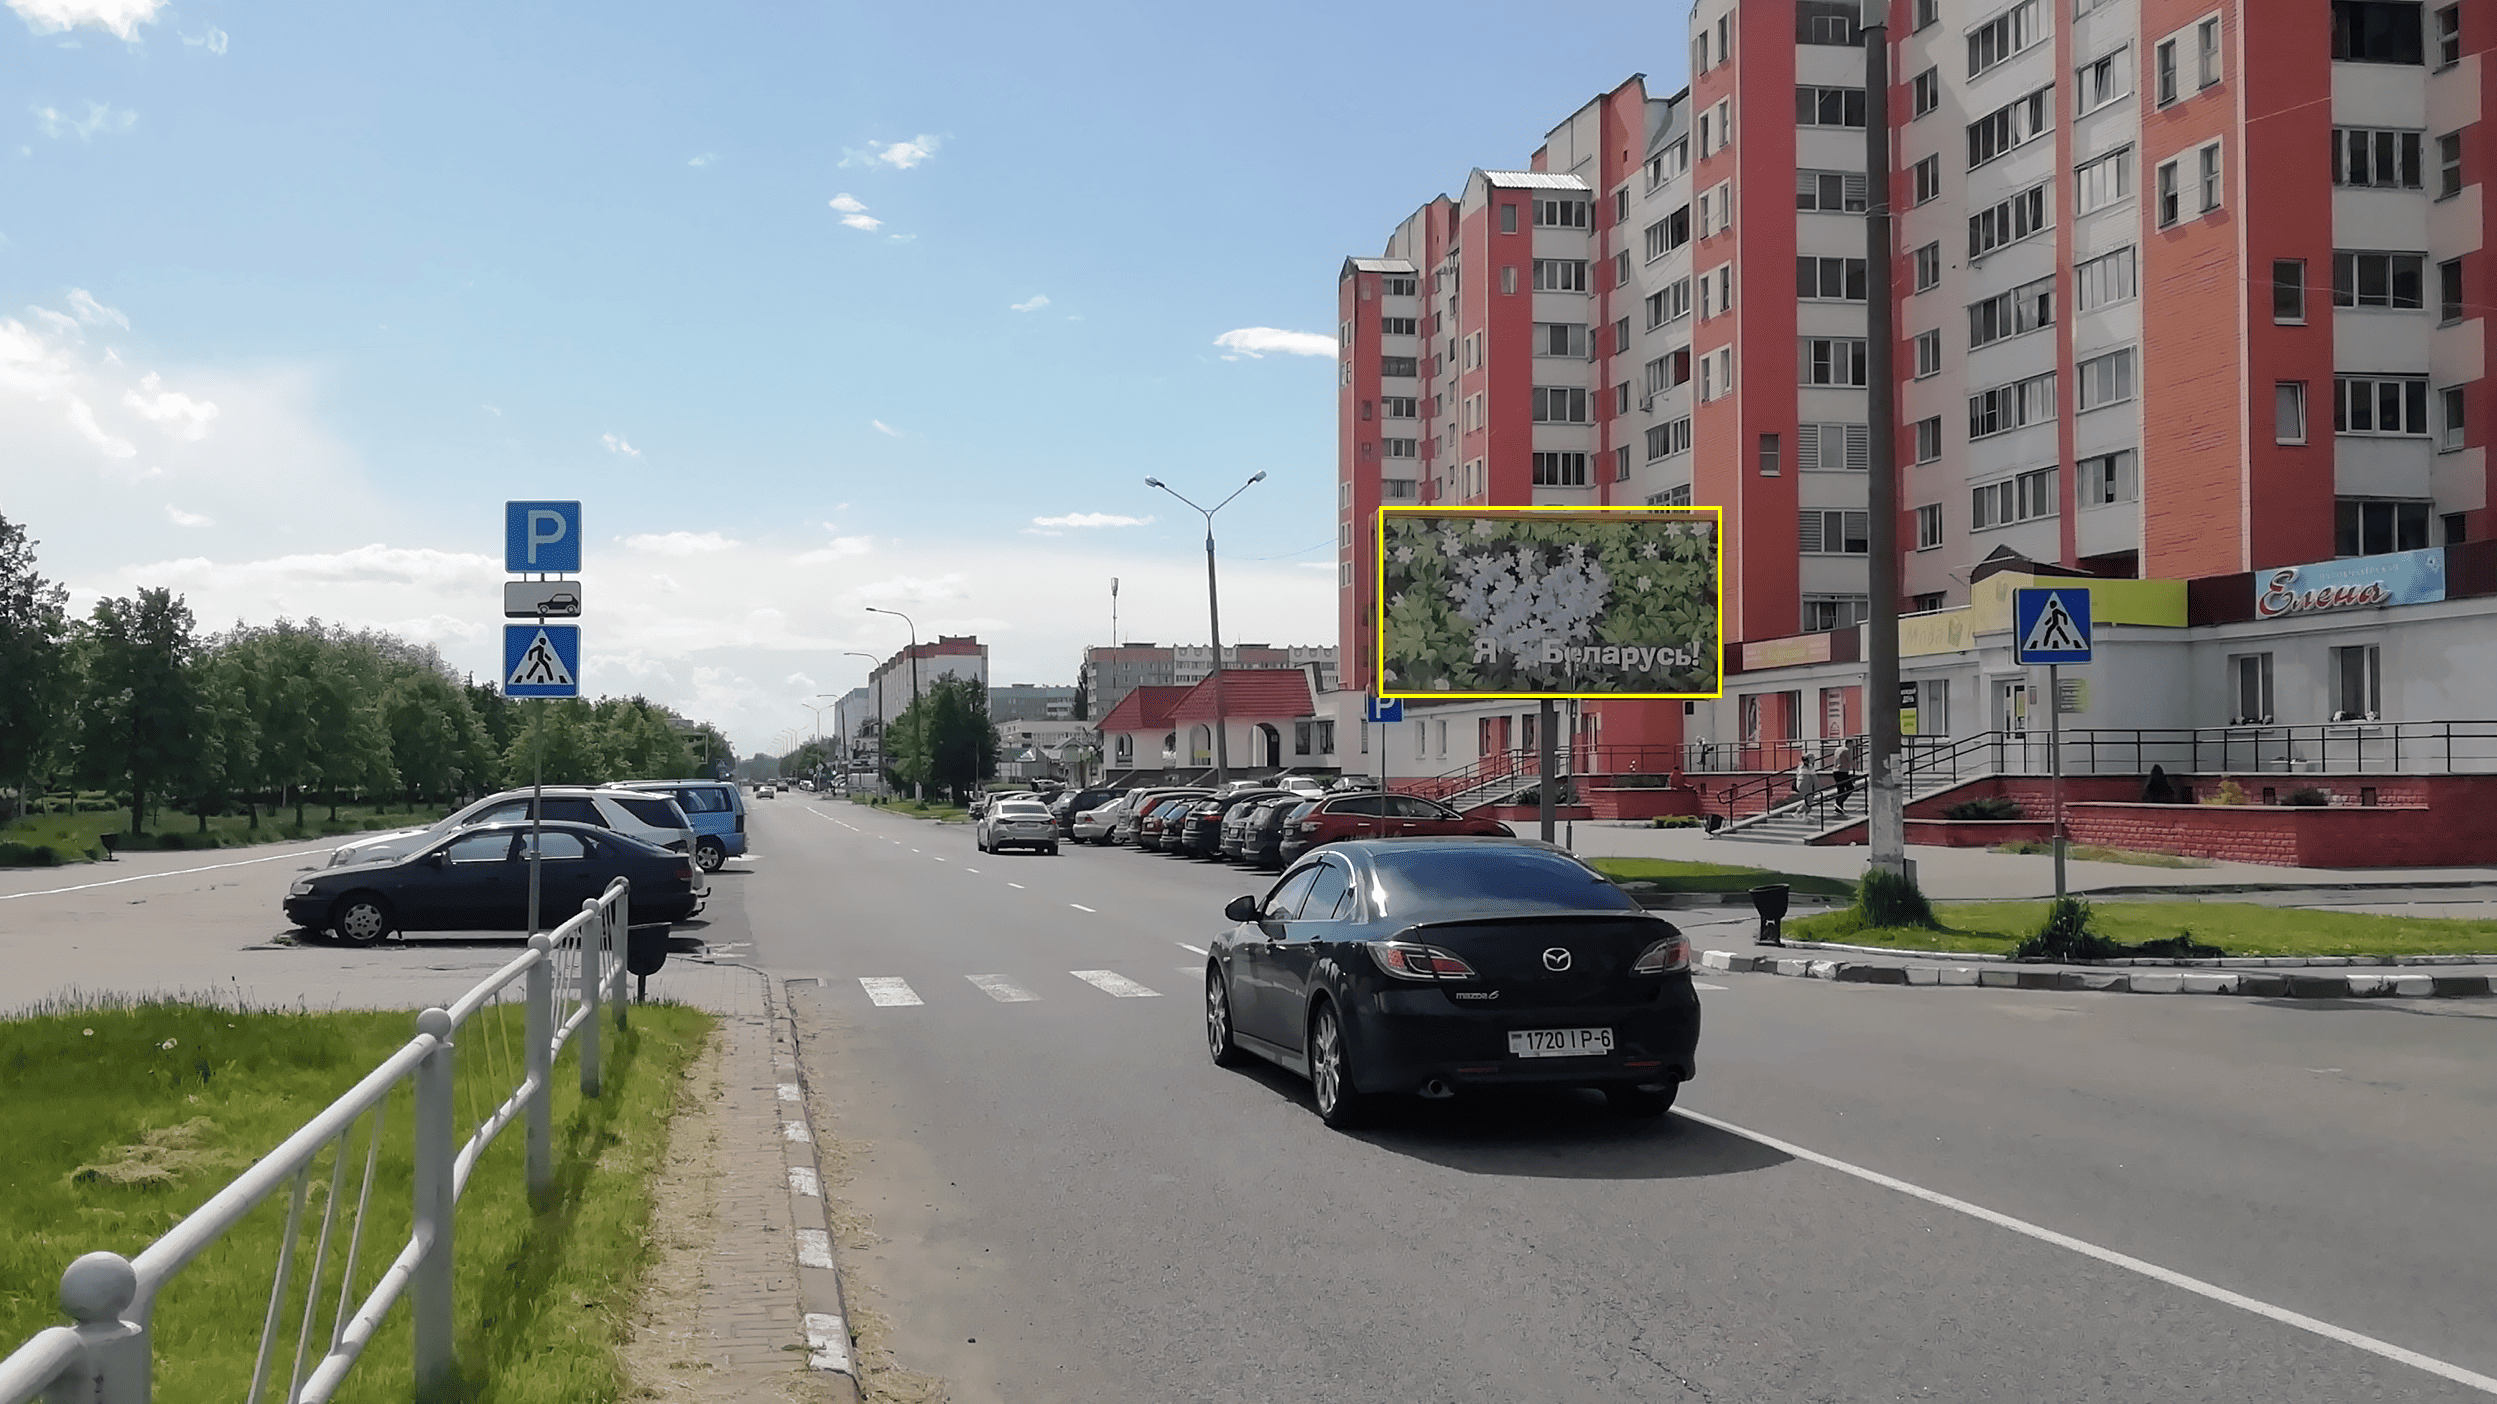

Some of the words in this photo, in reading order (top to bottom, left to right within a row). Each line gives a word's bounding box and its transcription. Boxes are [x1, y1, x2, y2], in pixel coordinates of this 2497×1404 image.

[527, 510, 566, 564] P
[2259, 570, 2391, 616] Елена
[1473, 637, 1497, 664] Я
[1541, 638, 1701, 673] Беларусь!
[1376, 697, 1396, 719] P
[1527, 1031, 1565, 1050] 1720
